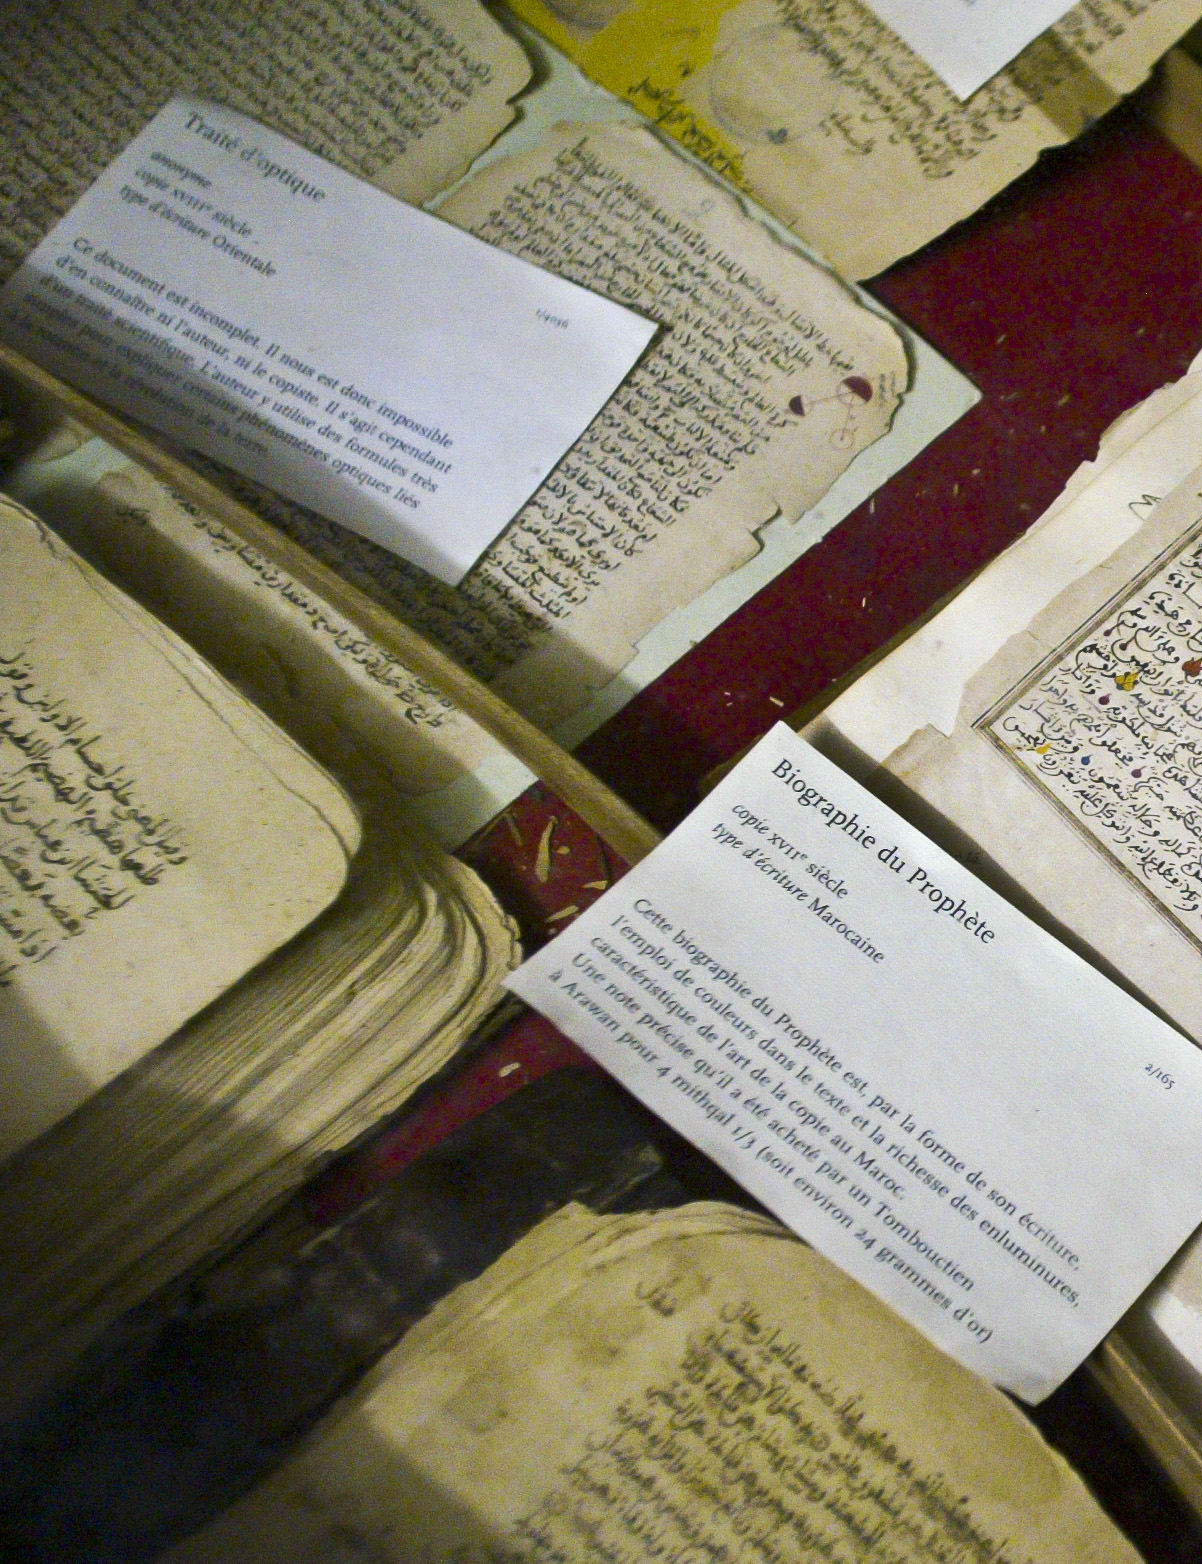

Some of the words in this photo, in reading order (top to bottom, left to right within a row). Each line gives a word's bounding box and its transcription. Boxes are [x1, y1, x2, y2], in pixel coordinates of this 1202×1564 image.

[183, 110, 241, 153] Traité
[238, 145, 326, 203] d'optique
[54, 253, 88, 281] d'en
[87, 274, 156, 316] connaître
[154, 310, 175, 327] ni
[172, 317, 230, 361] l'auteur,
[232, 354, 253, 371] ni
[250, 360, 268, 378] le
[267, 373, 320, 407] copiste.
[322, 399, 341, 416] Il
[336, 409, 379, 436] s'agit
[376, 430, 453, 474] cependant
[71, 235, 94, 255] Ce
[92, 248, 166, 296] document
[164, 289, 190, 308] est
[187, 299, 261, 350] incomplet.
[263, 341, 281, 358] Il
[277, 352, 316, 378] nous
[315, 372, 340, 390] est
[338, 383, 376, 409] donc
[375, 402, 454, 448] impossible
[710, 821, 745, 850] type
[740, 846, 809, 902] d'écriture
[805, 895, 885, 964] Marocaine
[730, 803, 770, 835] copie
[803, 862, 849, 900] siècle
[770, 756, 877, 850] Biographie
[875, 844, 906, 874] du
[904, 865, 996, 944] Prophète
[547, 968, 563, 983] à
[559, 981, 621, 1032] Arawan
[613, 1030, 660, 1063] pour
[655, 1065, 672, 1079] 4
[669, 1073, 737, 1127] mithqal
[730, 1124, 757, 1150] 1/3
[754, 1144, 795, 1178] (soit
[792, 1176, 854, 1229] environ
[853, 1227, 878, 1251] 24
[873, 1245, 953, 1310] grammes
[951, 1306, 994, 1345] d'or)
[570, 951, 607, 984] Une
[602, 982, 642, 1014] note
[634, 1011, 695, 1060] précise
[692, 1057, 735, 1090] qu'il
[728, 1087, 743, 1100] a
[741, 1096, 772, 1119] été
[765, 1118, 821, 1162] acheté
[813, 1159, 848, 1185] par
[846, 1183, 872, 1208] un
[872, 1200, 975, 1292] Tombouctien
[589, 936, 698, 1026] caractéristique
[695, 1023, 719, 1044] de
[715, 1036, 752, 1071] l'art
[748, 1066, 772, 1087] de
[768, 1080, 788, 1102] la
[786, 1098, 831, 1136] copie
[828, 1133, 854, 1155] au
[851, 1149, 905, 1201] Maroc.
[609, 913, 677, 971] l'emploi
[671, 967, 695, 988] de
[692, 985, 759, 1041] couleurs
[756, 1036, 797, 1072] dans
[793, 1064, 814, 1085] le
[812, 1080, 851, 1116] texte
[849, 1114, 870, 1132] et
[866, 1123, 886, 1146] la
[884, 1142, 950, 1198] richesse
[948, 1193, 979, 1221] des
[977, 1218, 1080, 1308] enluminures,
[632, 897, 674, 934] Cette
[670, 927, 752, 999] biographie
[749, 995, 775, 1018] du
[772, 1011, 843, 1073] Prophète
[841, 1070, 869, 1098] est,
[865, 1093, 901, 1119] par
[897, 1112, 917, 1135] la
[915, 1128, 966, 1174] forme
[964, 1169, 988, 1192] de
[985, 1188, 1018, 1217] son
[1017, 1211, 1080, 1271] écriture,
[1143, 1062, 1176, 1090] 2/165
